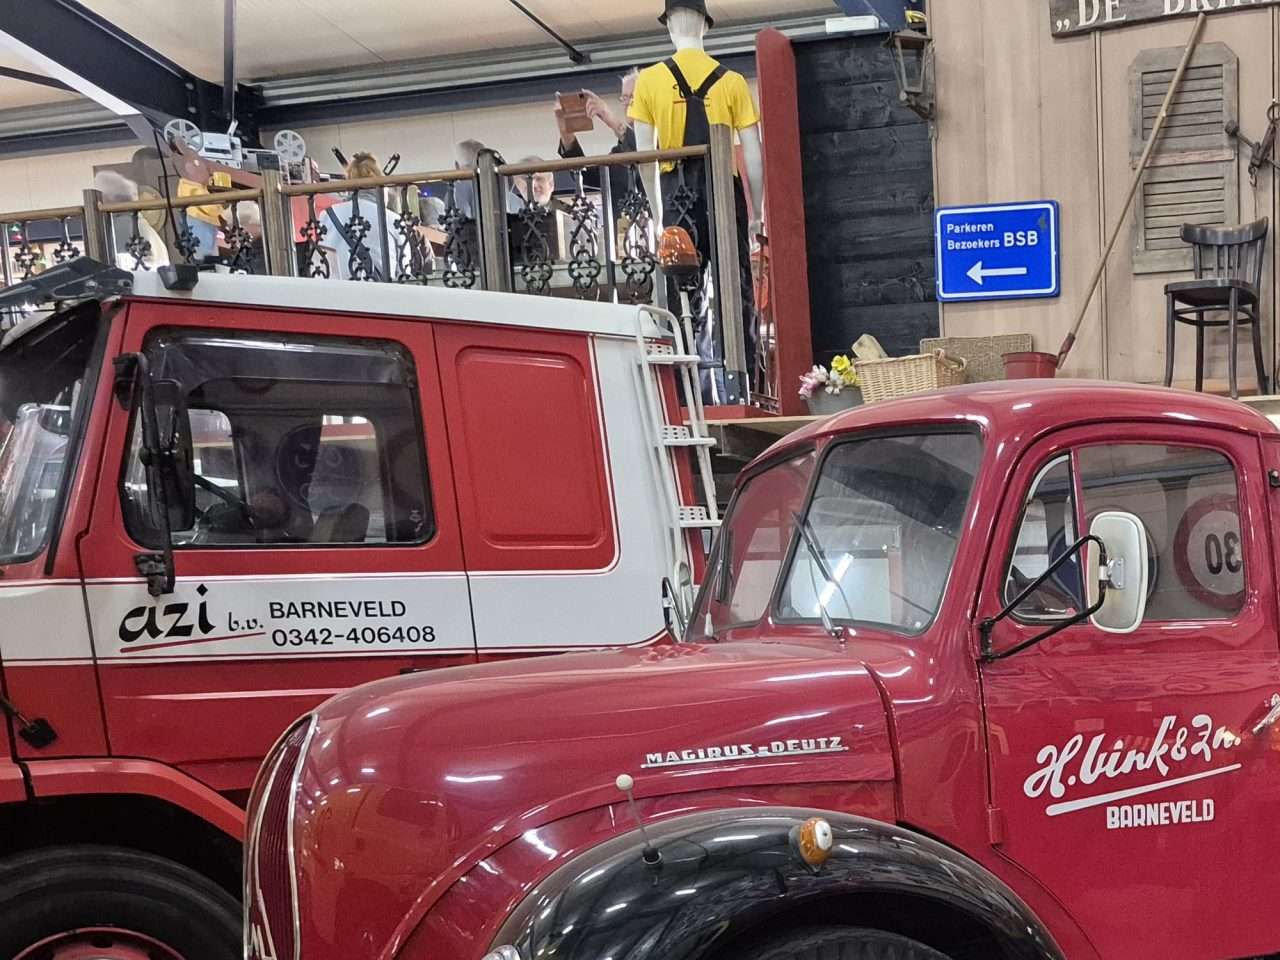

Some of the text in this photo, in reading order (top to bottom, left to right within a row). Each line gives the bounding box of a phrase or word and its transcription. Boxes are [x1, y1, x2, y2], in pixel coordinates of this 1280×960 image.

[947, 223, 994, 233] Parkeren
[947, 231, 1038, 250] Bezoekers BSB
[118, 583, 216, 643] azi
[269, 600, 406, 620] BARNEVELD
[271, 626, 436, 647] 0342-406408
[1106, 798, 1215, 829] BARNEVELD
